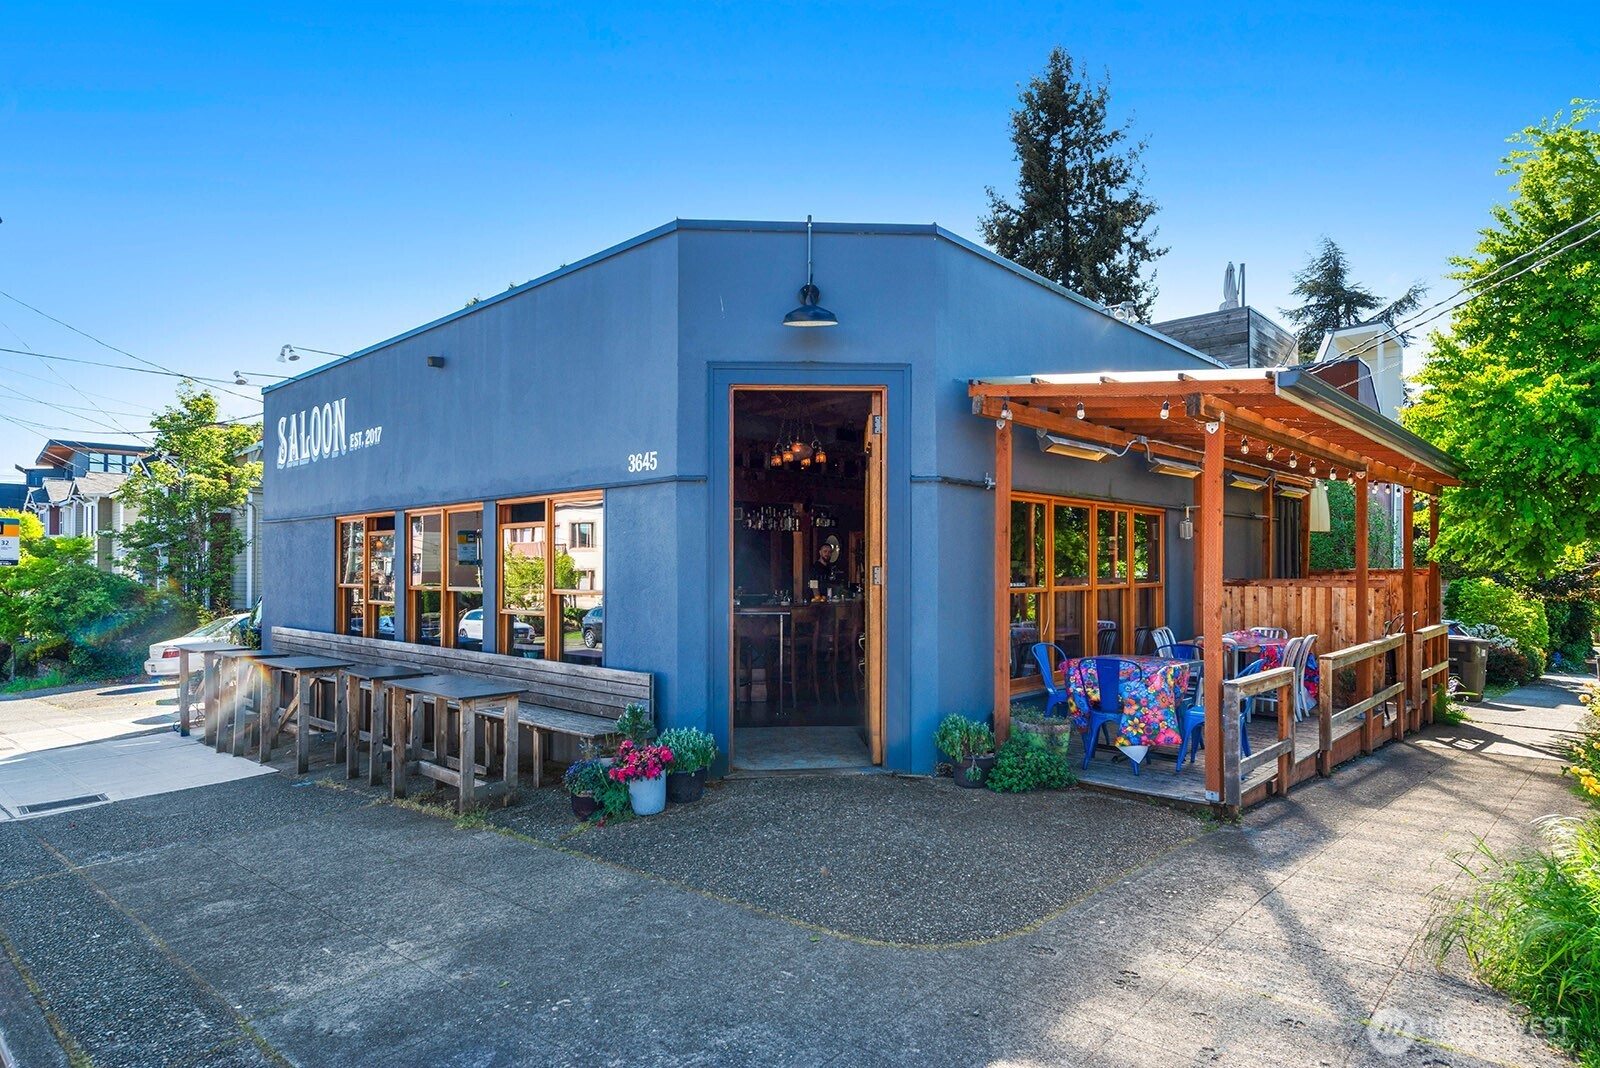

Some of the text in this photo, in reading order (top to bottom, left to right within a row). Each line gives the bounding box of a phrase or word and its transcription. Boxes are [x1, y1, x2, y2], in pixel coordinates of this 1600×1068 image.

[277, 397, 383, 470] SALOON EST. 2017
[628, 451, 658, 473] 3645
